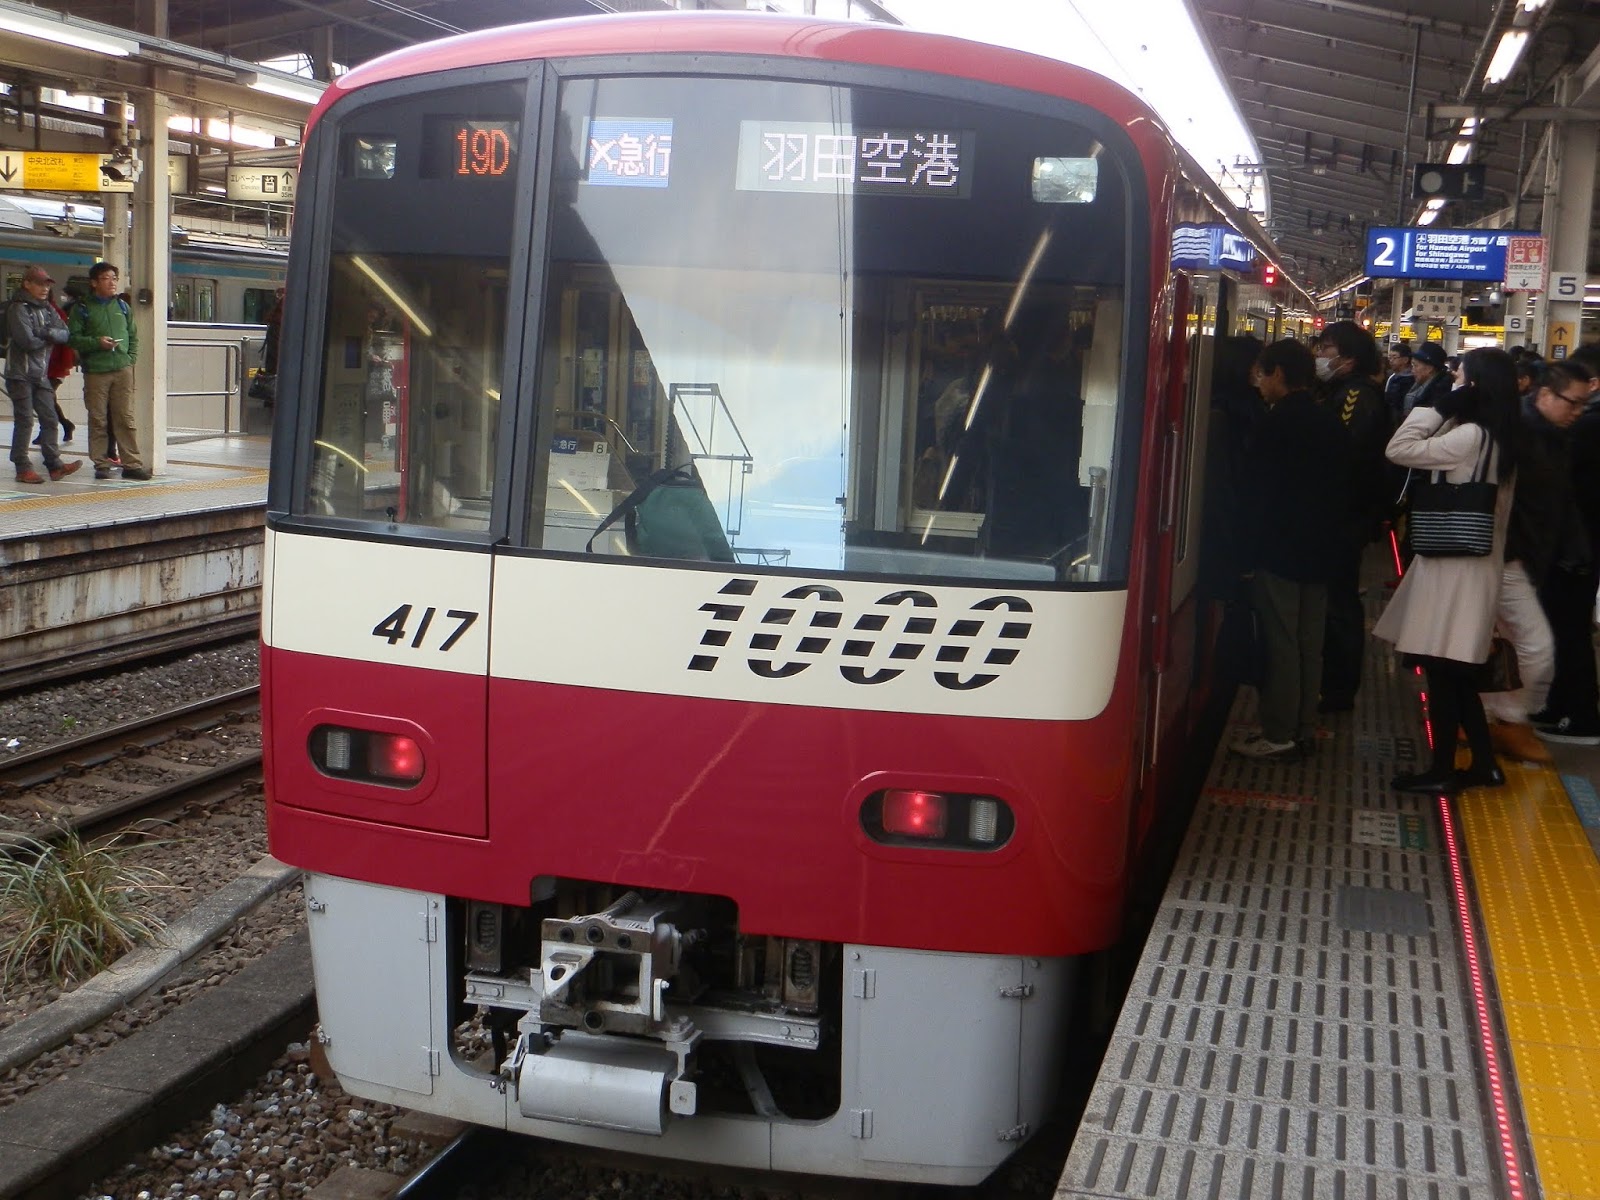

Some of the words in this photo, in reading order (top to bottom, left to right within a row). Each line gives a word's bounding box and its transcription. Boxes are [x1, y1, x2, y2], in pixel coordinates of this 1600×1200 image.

[455, 128, 511, 176] 19D
[762, 132, 960, 187] 羽田空港
[231, 174, 261, 183] エレベーター
[1429, 244, 1458, 252] Haneda
[1458, 245, 1487, 253] Airport
[1513, 240, 1541, 248] STOP
[1373, 237, 1395, 267] 2
[1428, 250, 1470, 259] Shinagawa
[1558, 276, 1577, 295] 5
[1510, 317, 1521, 329] 6
[596, 444, 604, 454] 8
[371, 603, 479, 652] 417
[686, 577, 1034, 692] 1000
